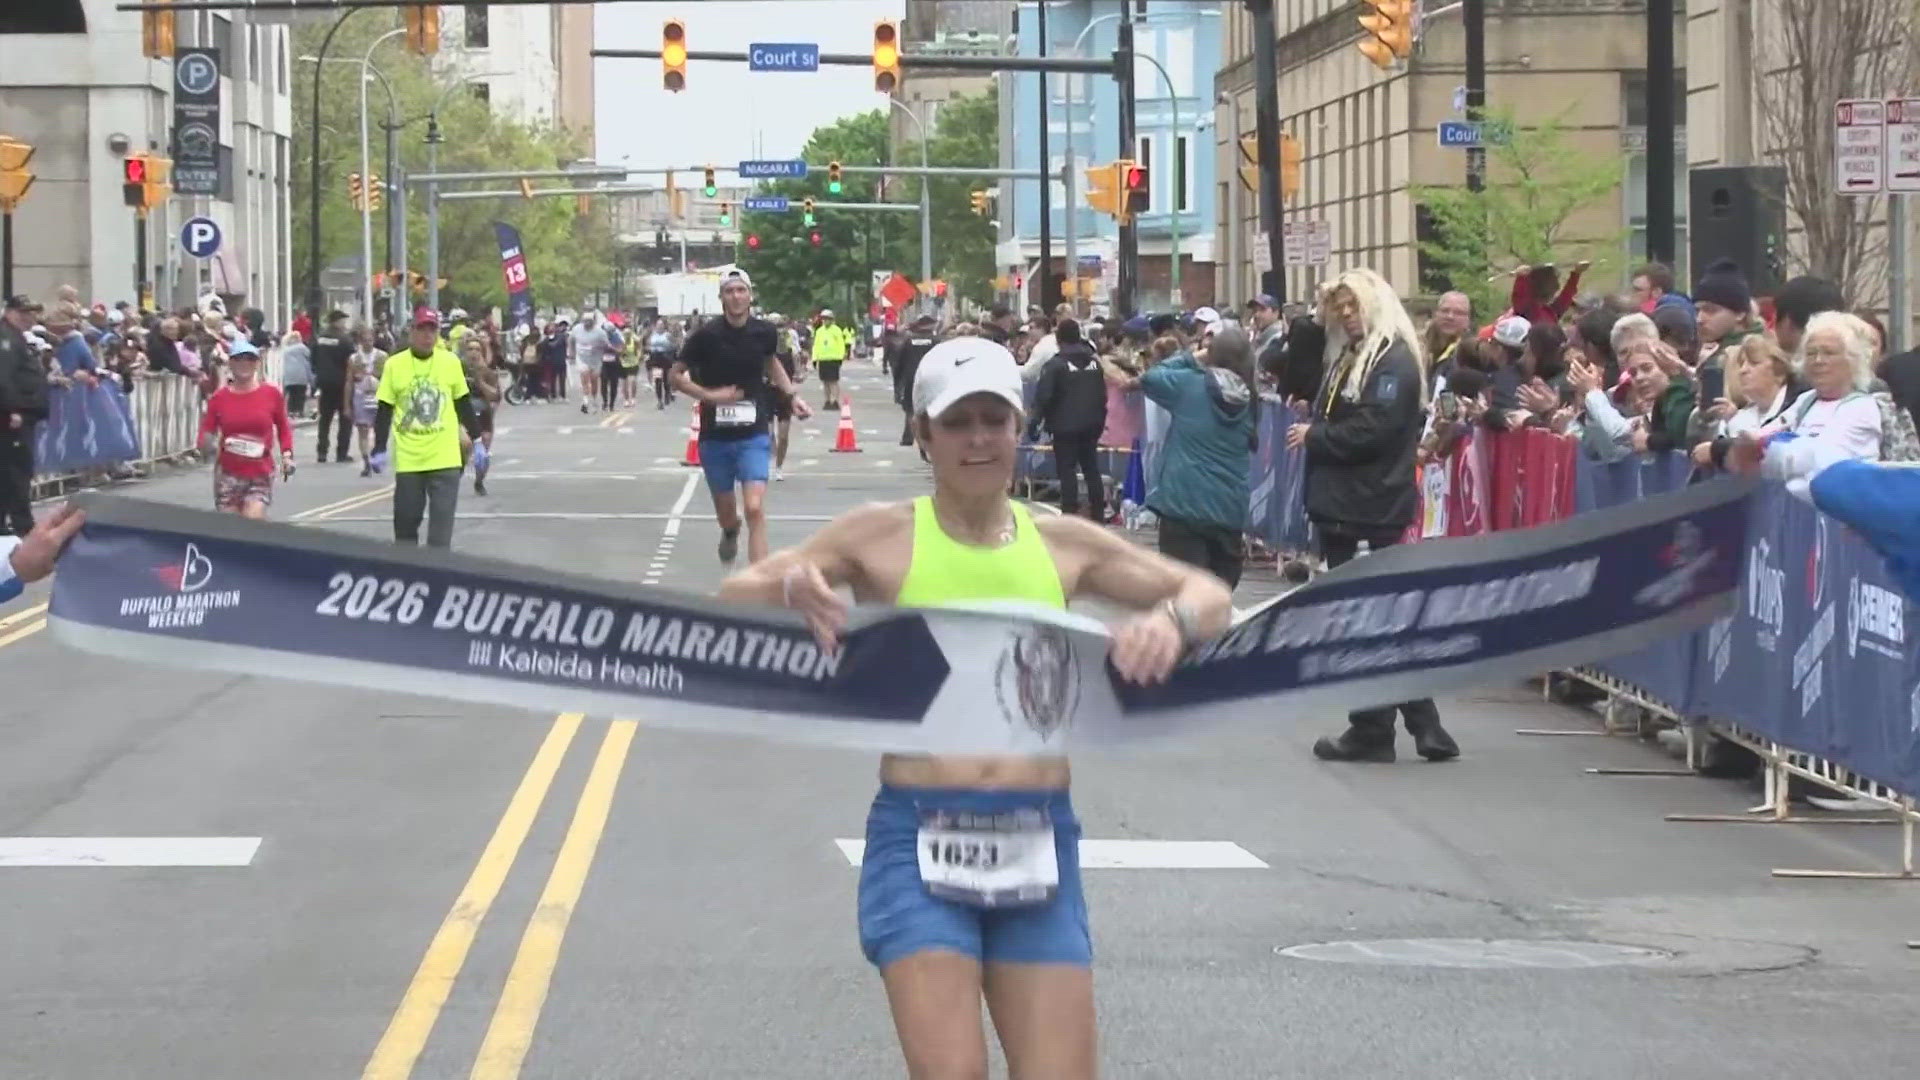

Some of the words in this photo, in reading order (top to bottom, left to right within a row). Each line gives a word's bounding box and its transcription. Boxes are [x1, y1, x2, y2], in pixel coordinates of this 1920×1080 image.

[753, 49, 797, 66] Court
[745, 164, 790, 174] NIAGARA
[191, 223, 214, 252] P
[506, 262, 527, 284] 13
[120, 596, 172, 616] BUFFALO
[175, 590, 241, 611] MARATHON
[148, 610, 205, 628] WEEKEND
[316, 571, 430, 624] 2026
[433, 585, 614, 648] BUFFALO
[620, 612, 847, 681] MARATHON
[498, 642, 593, 680] Kaleida
[600, 654, 684, 693] Health
